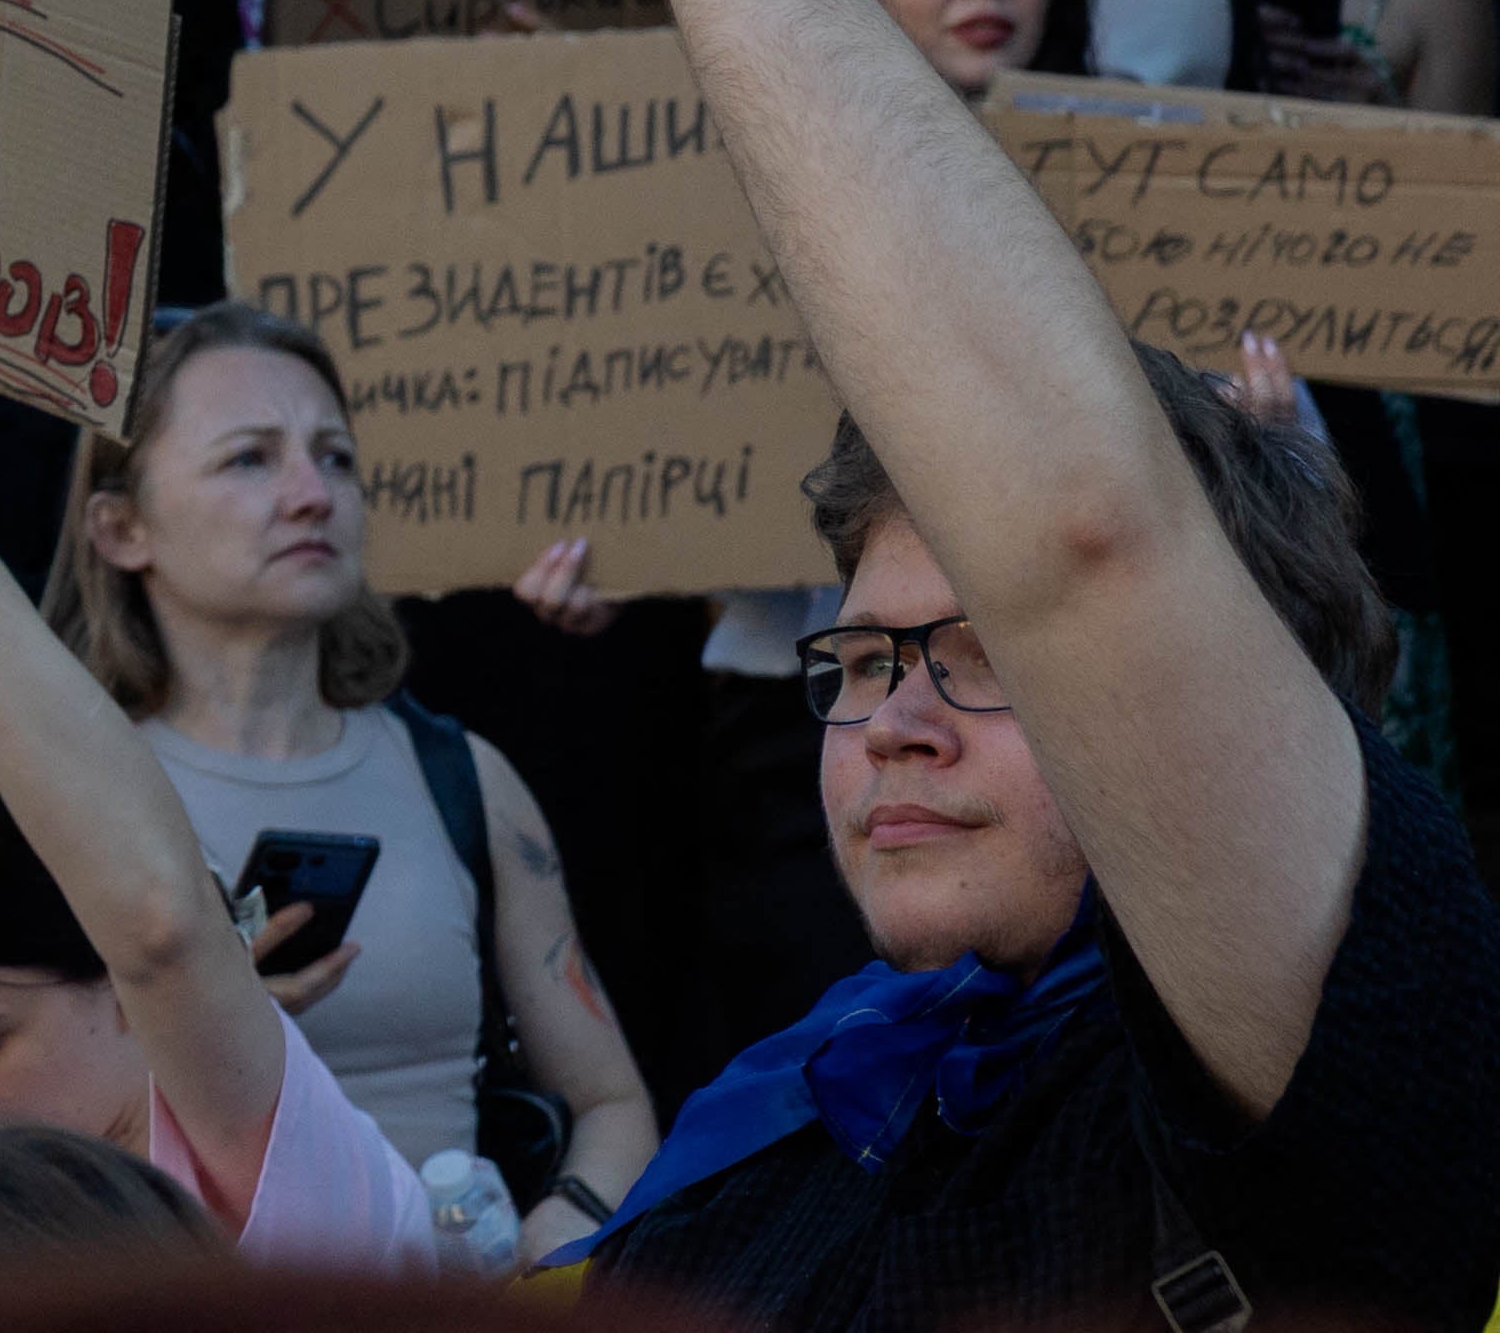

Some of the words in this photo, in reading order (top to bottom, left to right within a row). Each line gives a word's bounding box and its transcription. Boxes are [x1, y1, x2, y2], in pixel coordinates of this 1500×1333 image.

[289, 95, 386, 218] У
[433, 92, 714, 215] НАШИ
[1199, 141, 1399, 209] САМО
[258, 241, 688, 353] ПРЕЗИДЕНТІВ
[348, 366, 482, 416] ИЧКА:
[362, 450, 480, 526] НЯНІ
[516, 443, 754, 527] ПАПІРЦІ
